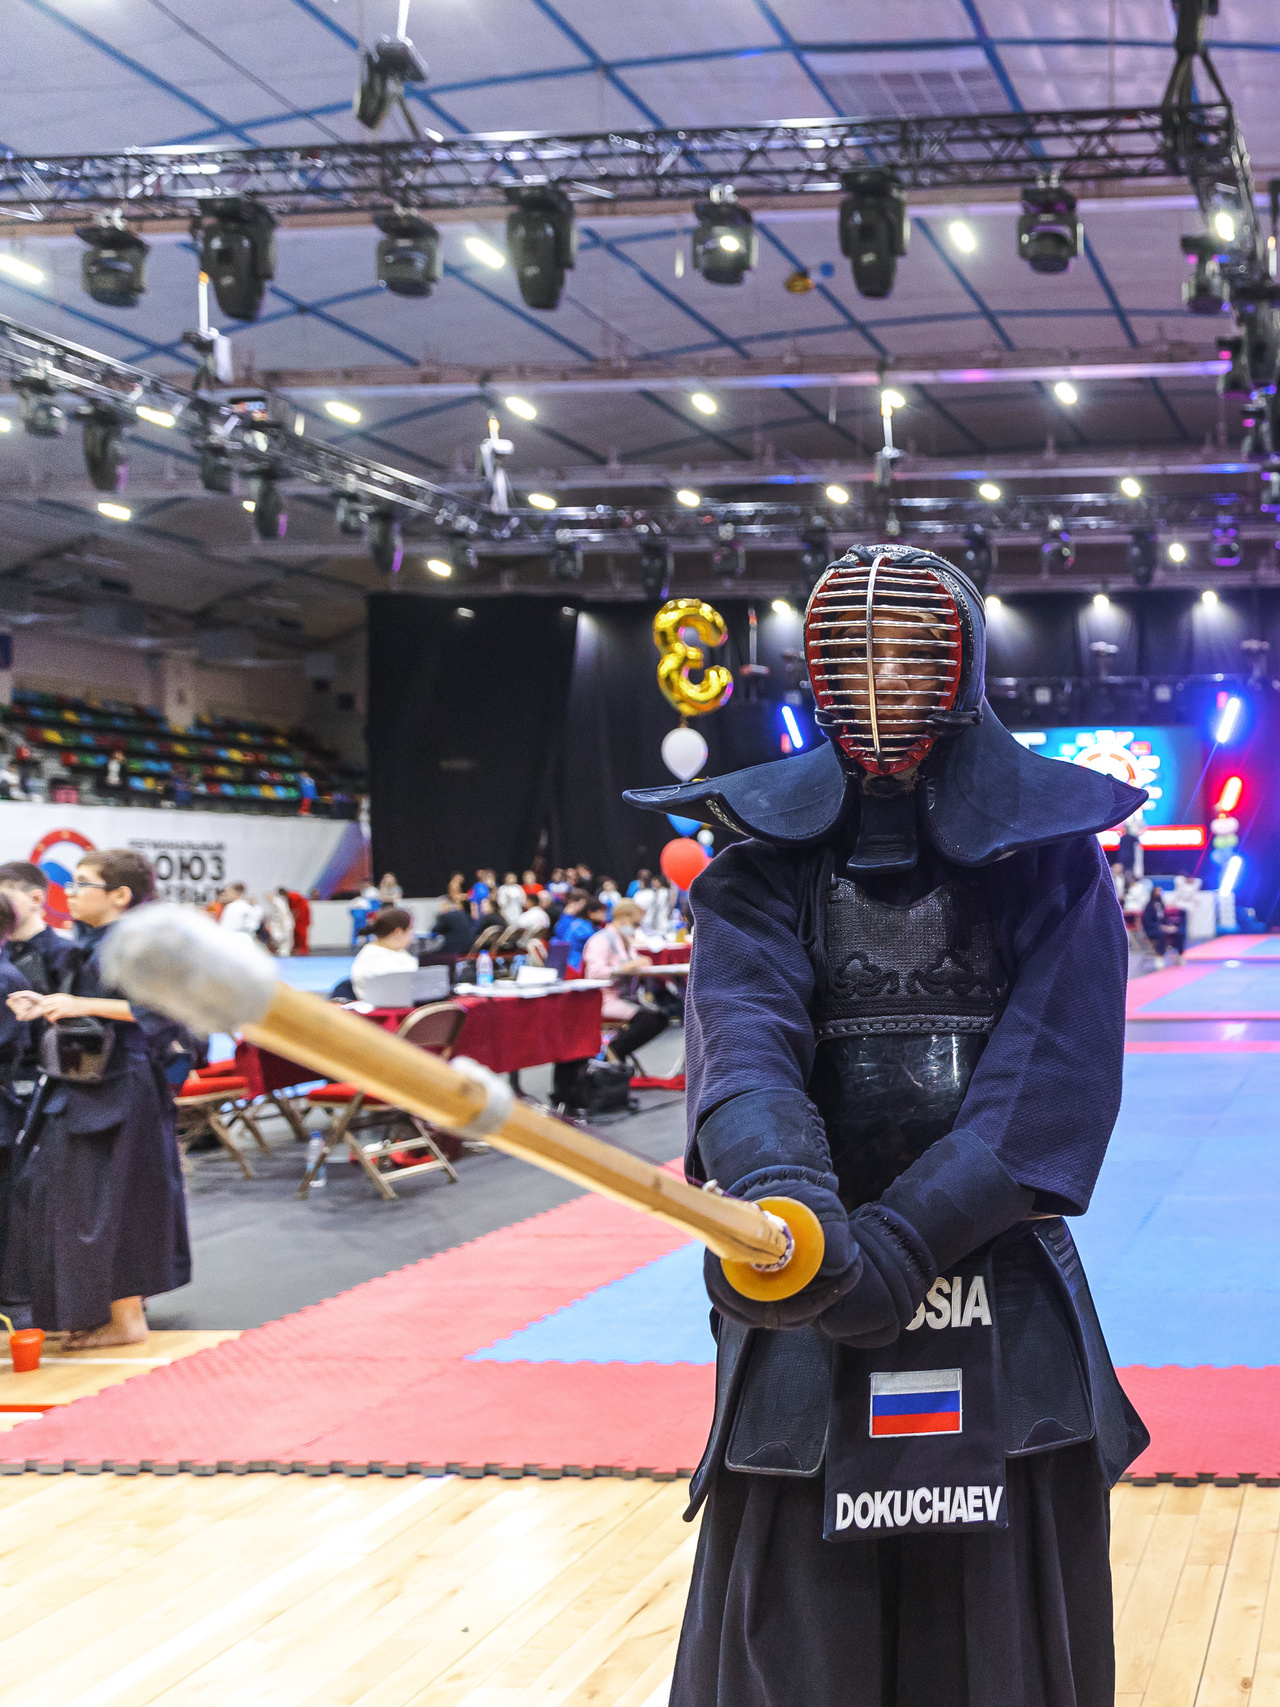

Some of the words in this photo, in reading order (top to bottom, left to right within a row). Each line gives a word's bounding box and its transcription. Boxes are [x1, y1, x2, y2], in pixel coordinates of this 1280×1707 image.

[155, 853, 225, 881] ОЮЗ
[905, 1275, 993, 1331] SIA
[835, 1485, 1004, 1531] DOKUCHAEV
